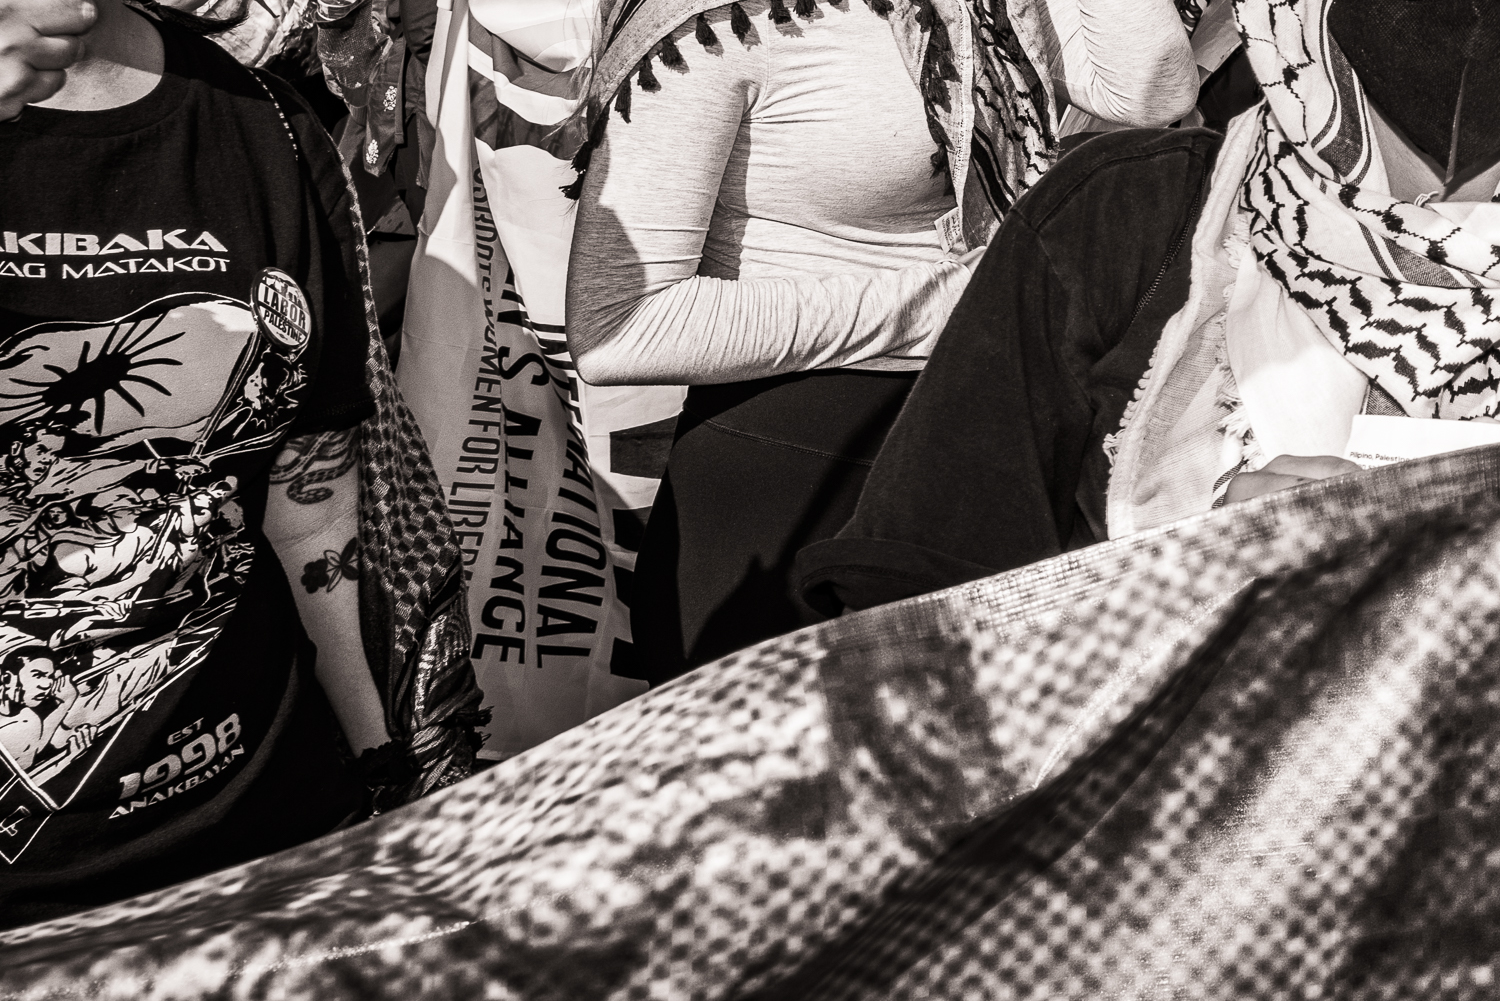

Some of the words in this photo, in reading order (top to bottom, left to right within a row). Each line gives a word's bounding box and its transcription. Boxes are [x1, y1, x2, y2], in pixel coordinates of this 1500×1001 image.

[0, 228, 229, 256] KIBAKA
[62, 256, 231, 280] MATAKOT
[263, 285, 306, 330] LABOR
[456, 418, 502, 475] FOR
[525, 319, 605, 668] INTENATIONAL
[470, 408, 544, 665] ALLIANCE
[118, 712, 242, 800] 1998
[167, 716, 205, 746] EST
[108, 743, 245, 820] ANAKBAYAN
